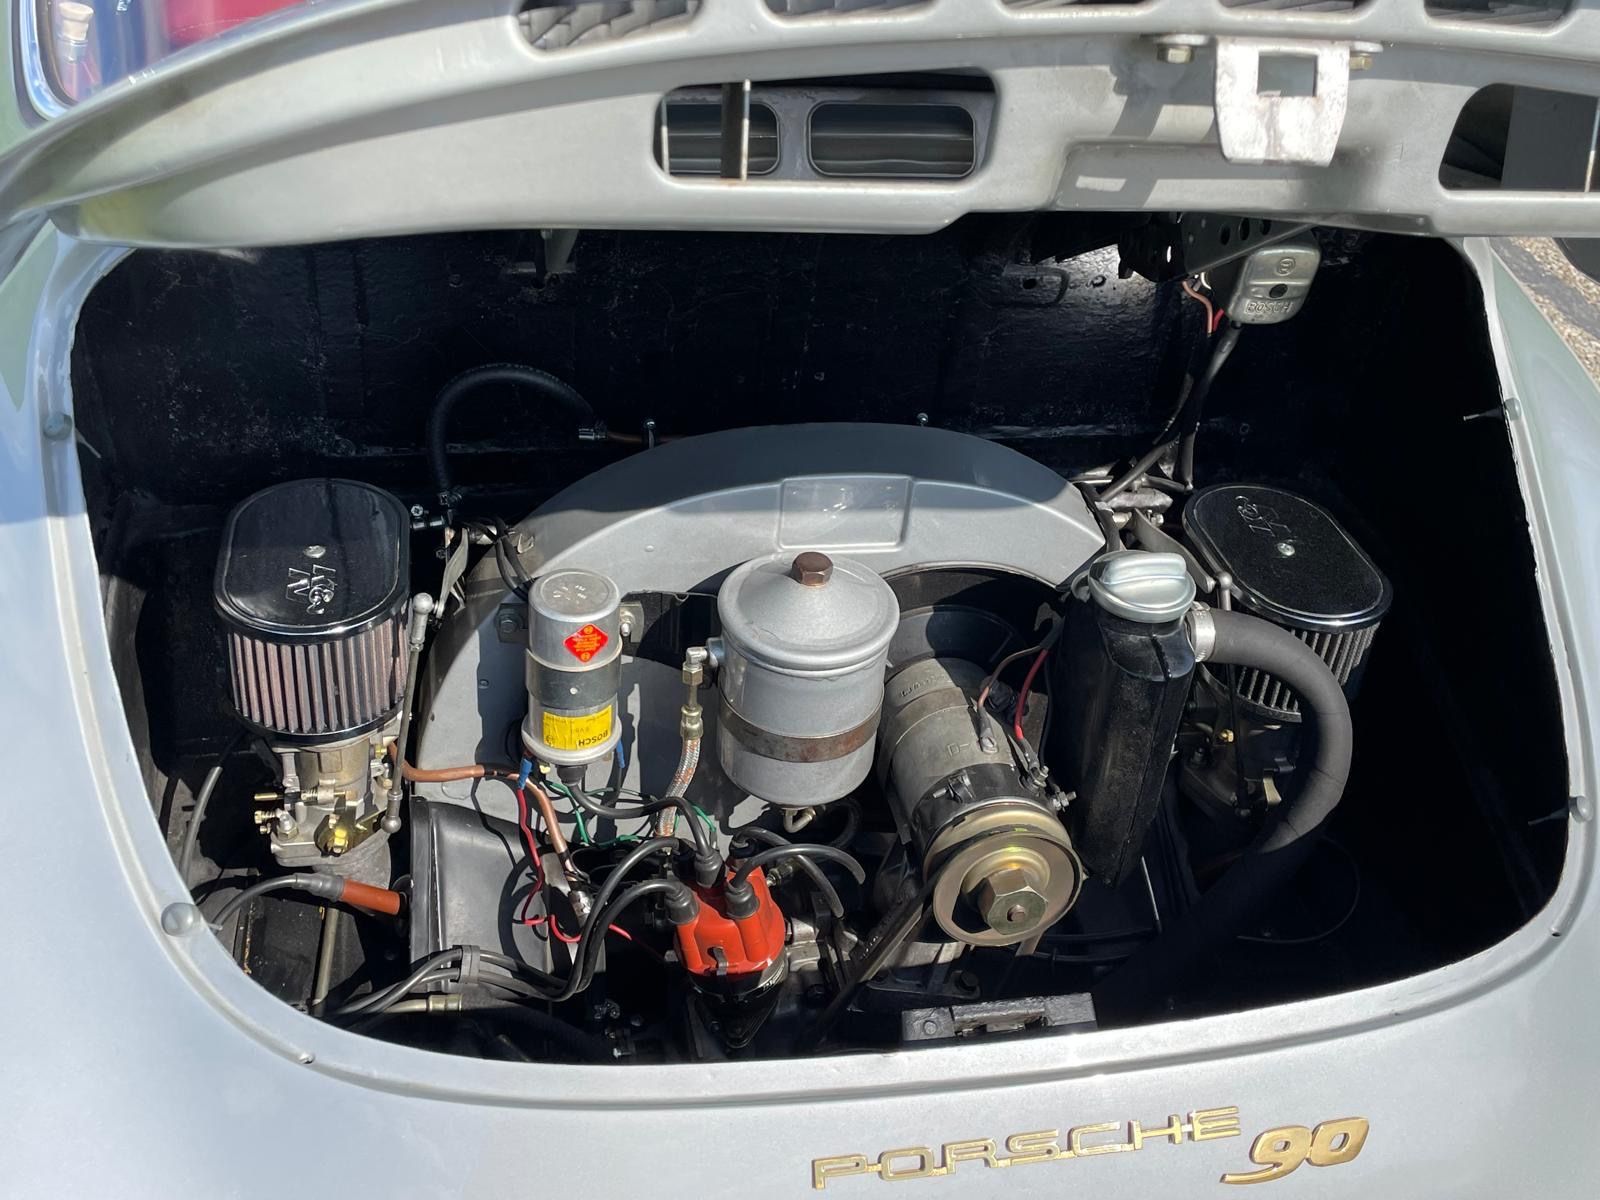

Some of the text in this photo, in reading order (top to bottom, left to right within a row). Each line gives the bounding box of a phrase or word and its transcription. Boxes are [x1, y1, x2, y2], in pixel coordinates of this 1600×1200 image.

[1244, 299, 1293, 314] BOSCH
[578, 730, 608, 747] BOSCH
[812, 1105, 1370, 1190] PORSCHE 90
